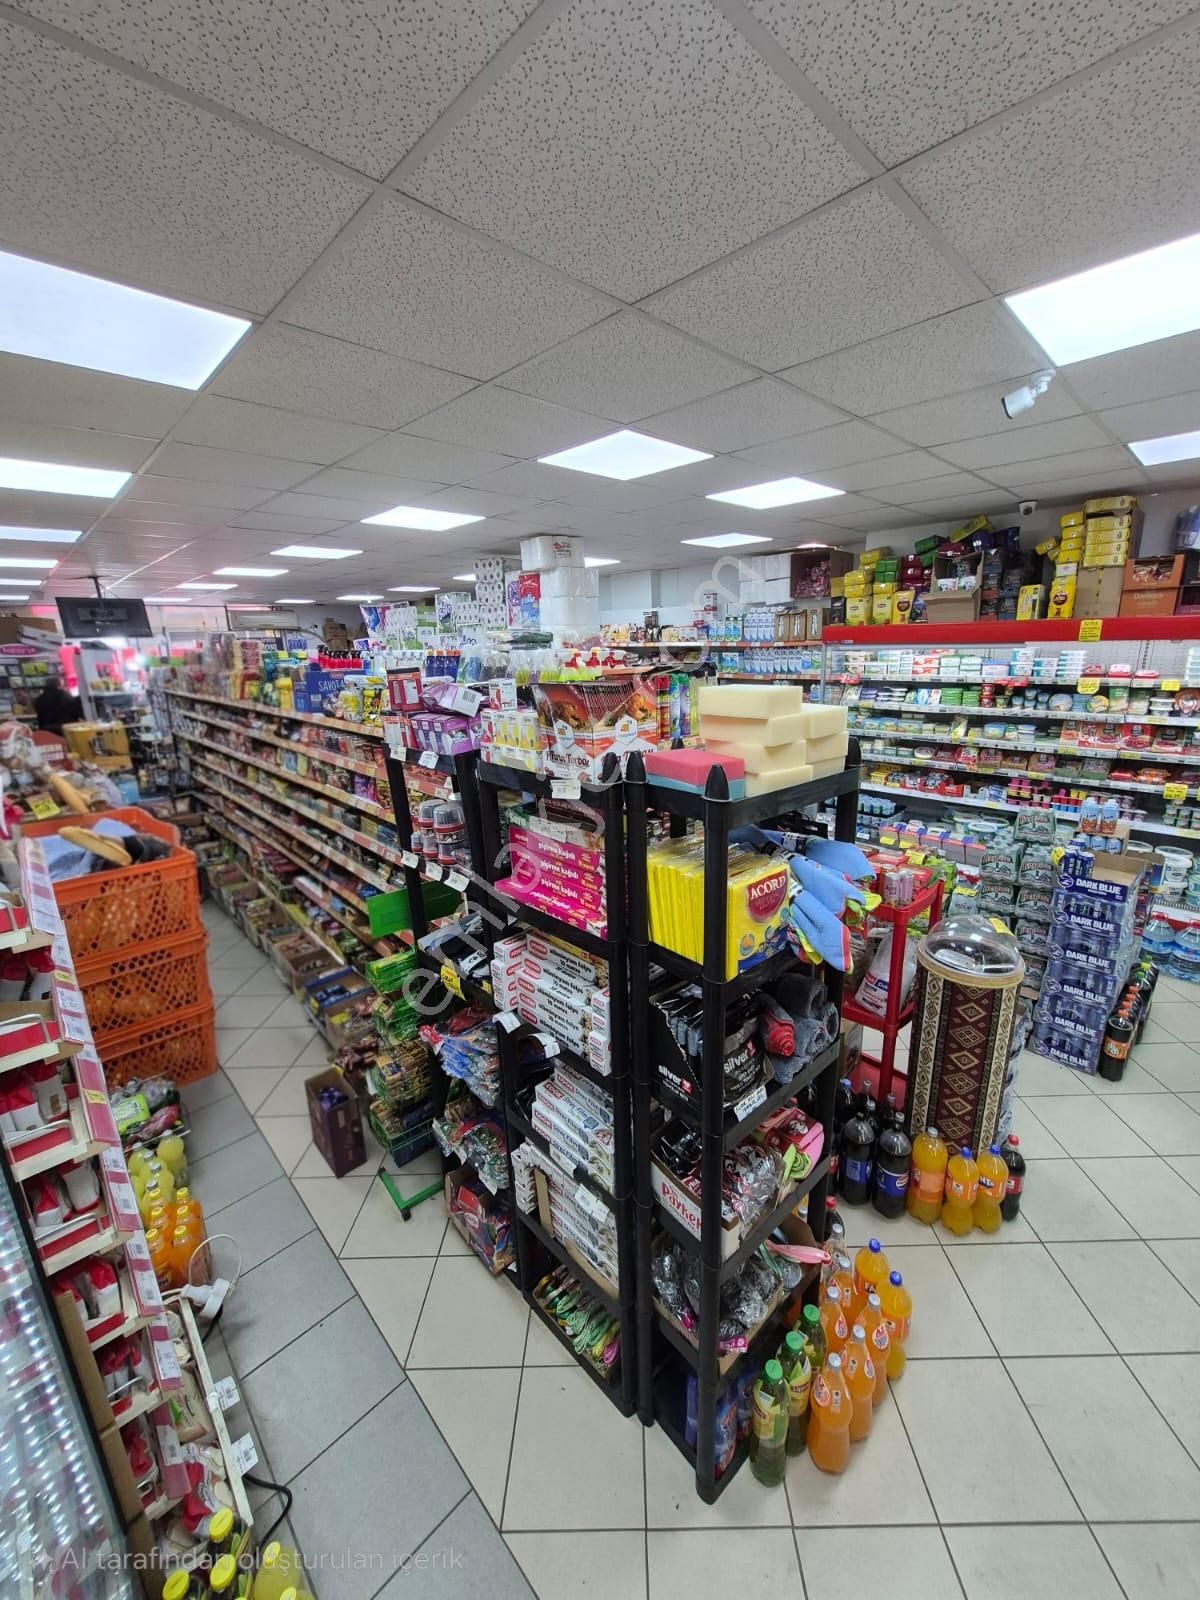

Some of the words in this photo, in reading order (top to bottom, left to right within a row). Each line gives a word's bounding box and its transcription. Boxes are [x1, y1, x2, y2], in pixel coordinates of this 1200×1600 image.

[750, 875, 786, 900] ACORD
[1075, 878, 1098, 891] DARK
[1098, 882, 1122, 895] BLUE
[1070, 914, 1093, 928] DARK
[1093, 919, 1115, 932] BLUE
[1065, 949, 1088, 963] DARK
[1088, 955, 1110, 969] BLUE
[1063, 984, 1086, 998] DARK
[1086, 991, 1107, 1005] BLUE
[1054, 1015, 1076, 1029] DARK
[1076, 1022, 1097, 1037] BLUE
[723, 1048, 749, 1074] silver
[1050, 1047, 1070, 1061] DARK
[1069, 1054, 1090, 1068] BLUE
[658, 1065, 682, 1086] silver
[545, 1083, 563, 1099] COOK
